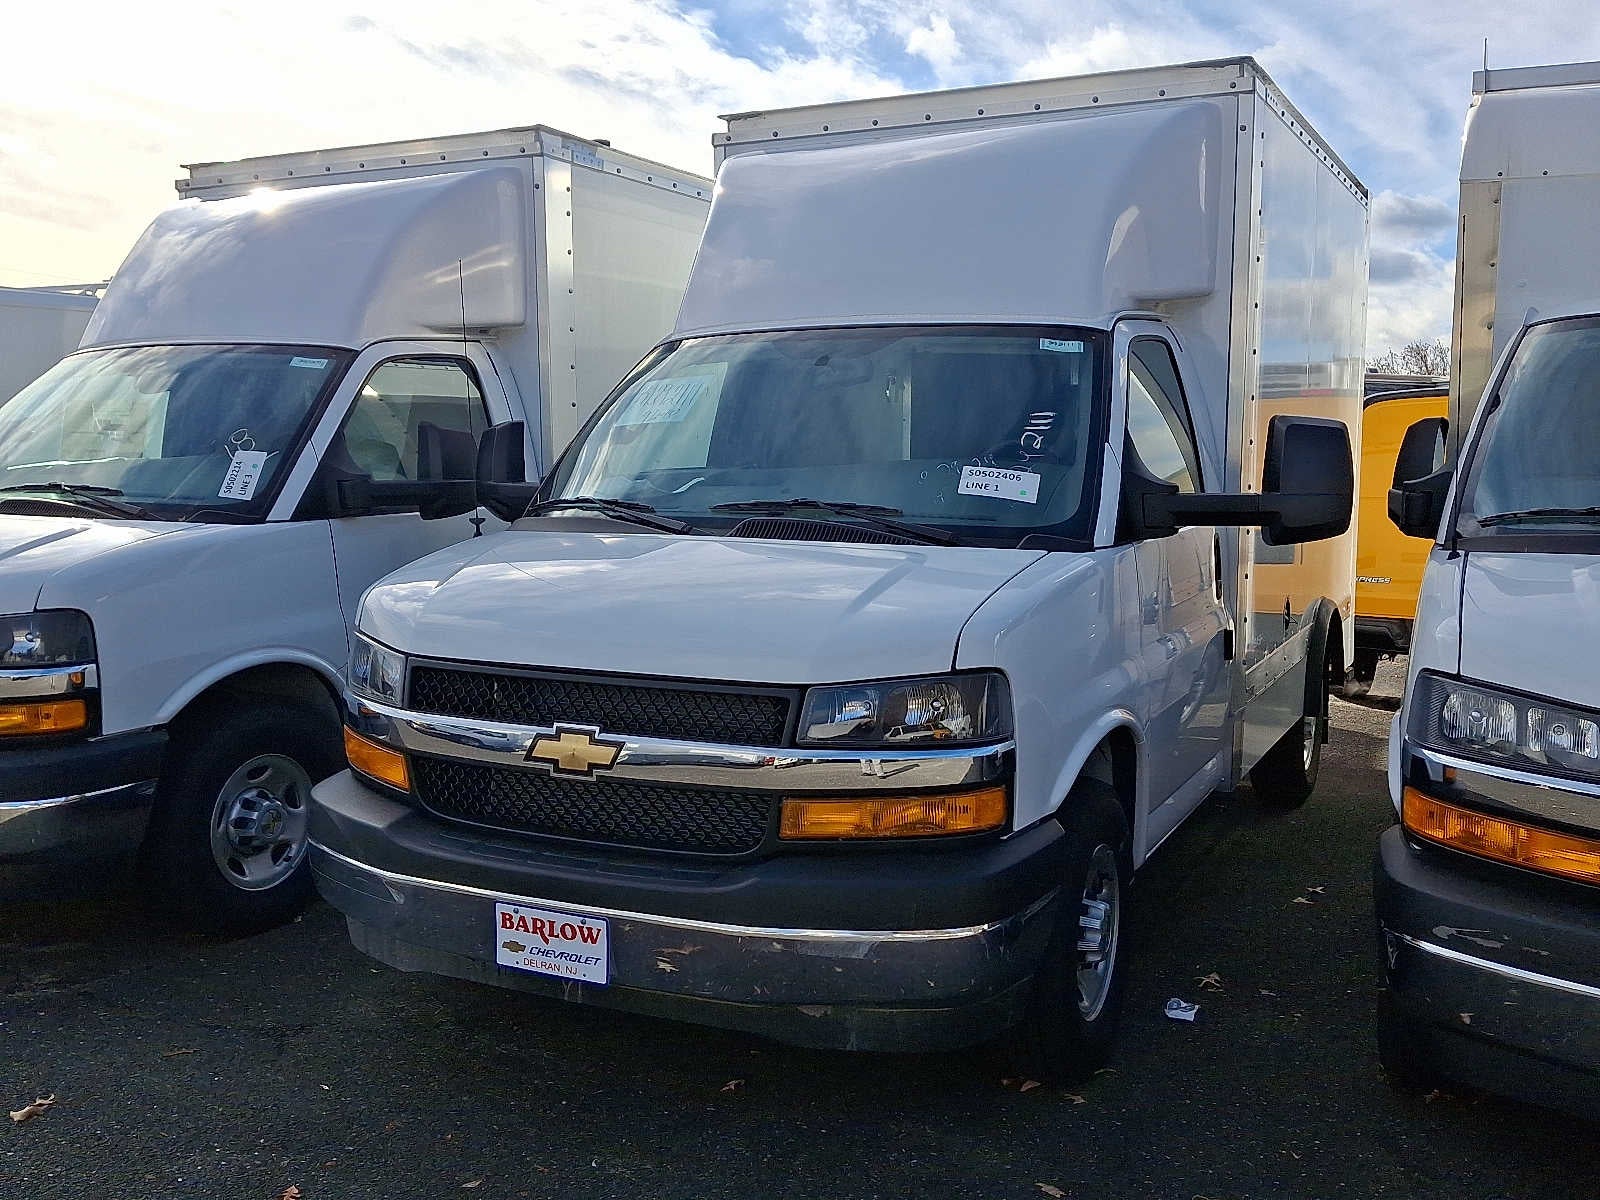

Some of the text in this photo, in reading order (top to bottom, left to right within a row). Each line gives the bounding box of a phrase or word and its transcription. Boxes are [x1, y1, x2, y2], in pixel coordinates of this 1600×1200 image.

[238, 481, 251, 496] LINE
[965, 481, 1000, 492] LINE 1
[500, 911, 601, 945] BARLOW
[528, 946, 602, 966] CHEVROLET
[523, 957, 578, 975] DELRAN, NJ
